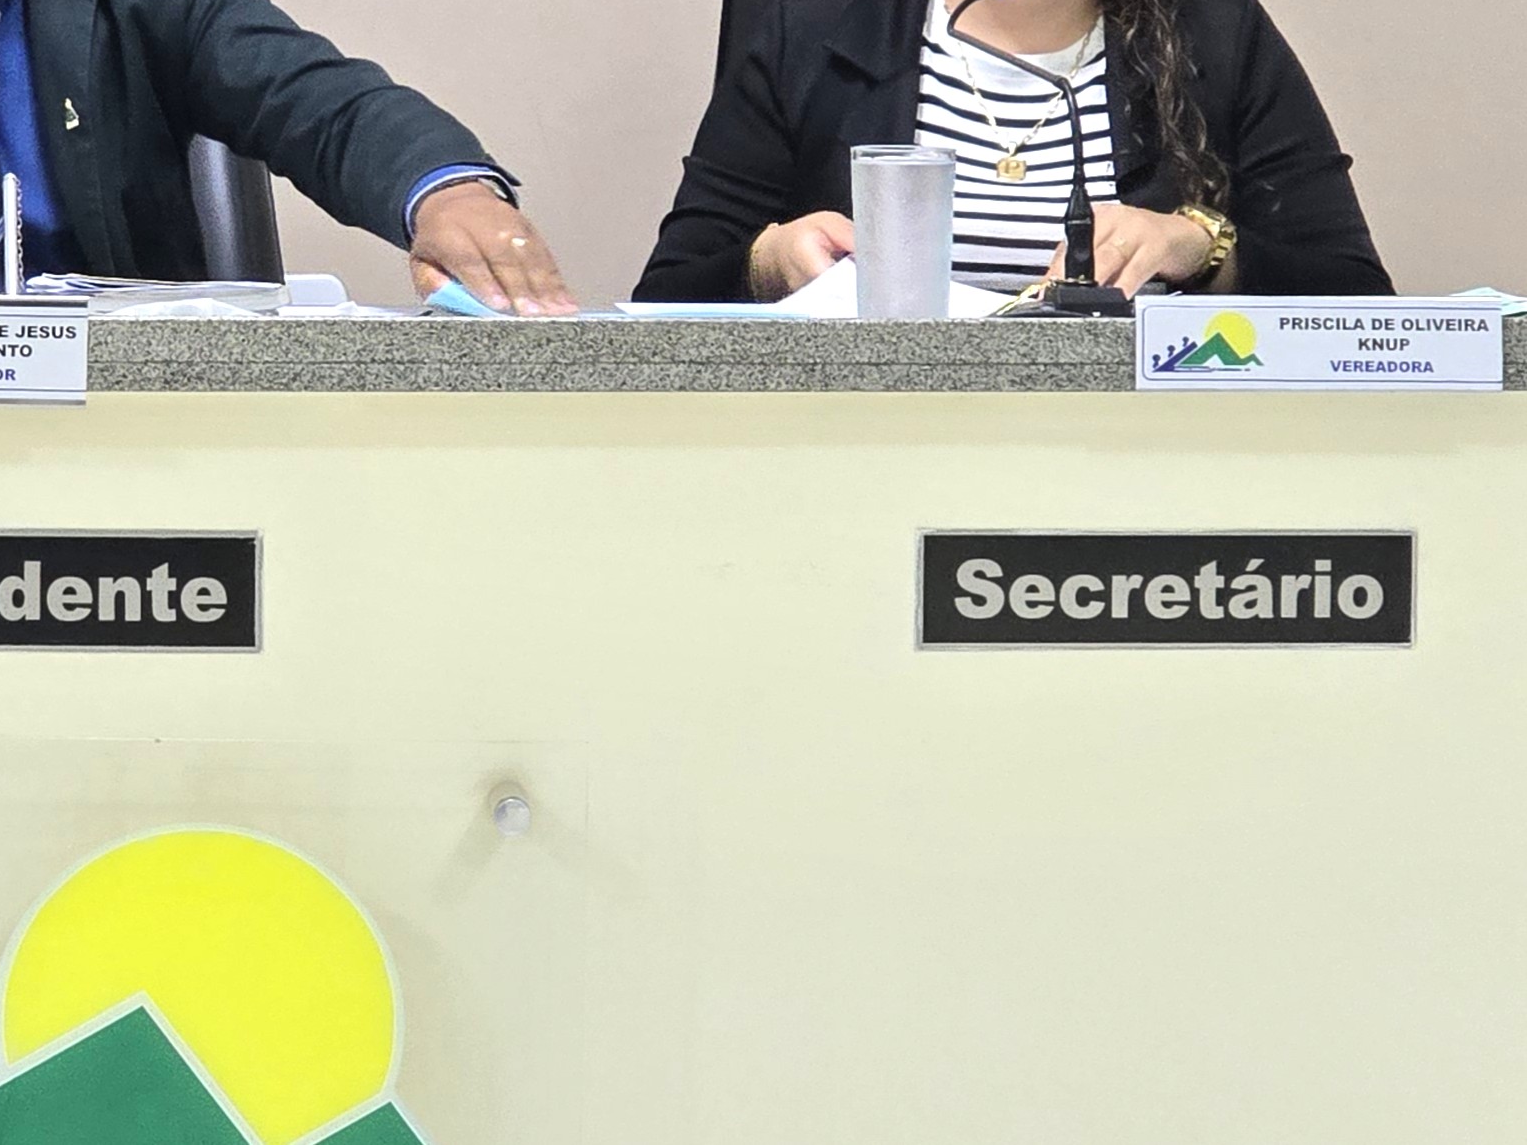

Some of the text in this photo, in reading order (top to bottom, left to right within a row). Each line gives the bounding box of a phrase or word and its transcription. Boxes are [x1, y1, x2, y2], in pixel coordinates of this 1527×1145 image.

[1279, 317, 1490, 332] PRISCILA DE OLIVEIRA
[14, 325, 77, 340] JESUS
[1358, 337, 1411, 352] KNUP
[1329, 359, 1435, 373] VEREADORA
[954, 558, 1385, 620] Secretário
